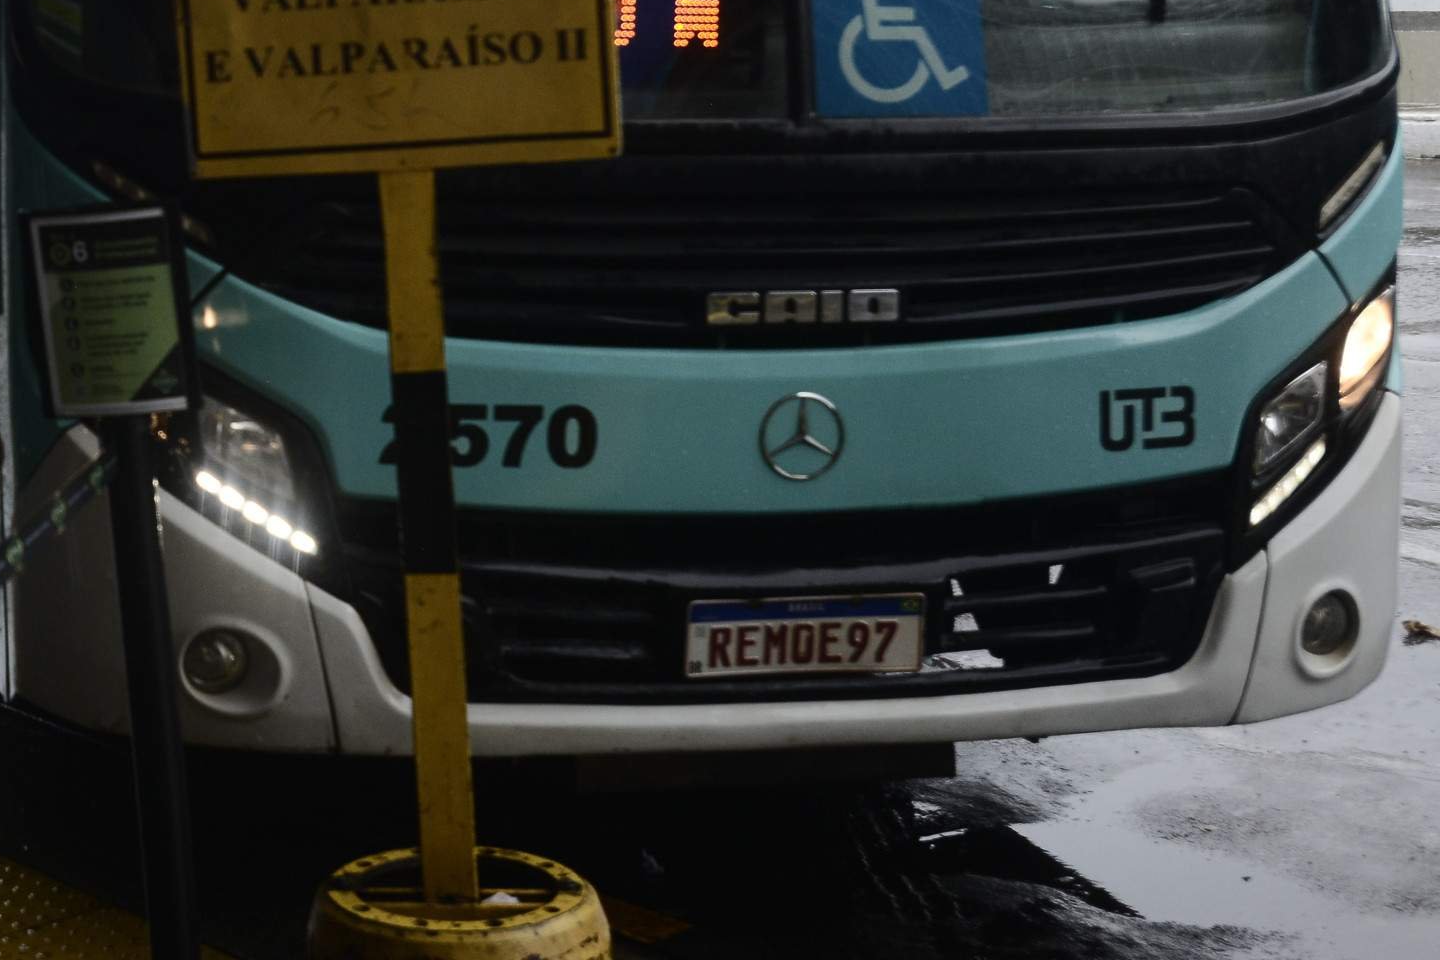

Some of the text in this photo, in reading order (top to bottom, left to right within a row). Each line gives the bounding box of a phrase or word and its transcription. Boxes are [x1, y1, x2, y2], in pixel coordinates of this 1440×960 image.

[204, 24, 589, 84] E VALPARAÍSO II
[71, 239, 89, 264] 6
[706, 288, 900, 326] CAIO
